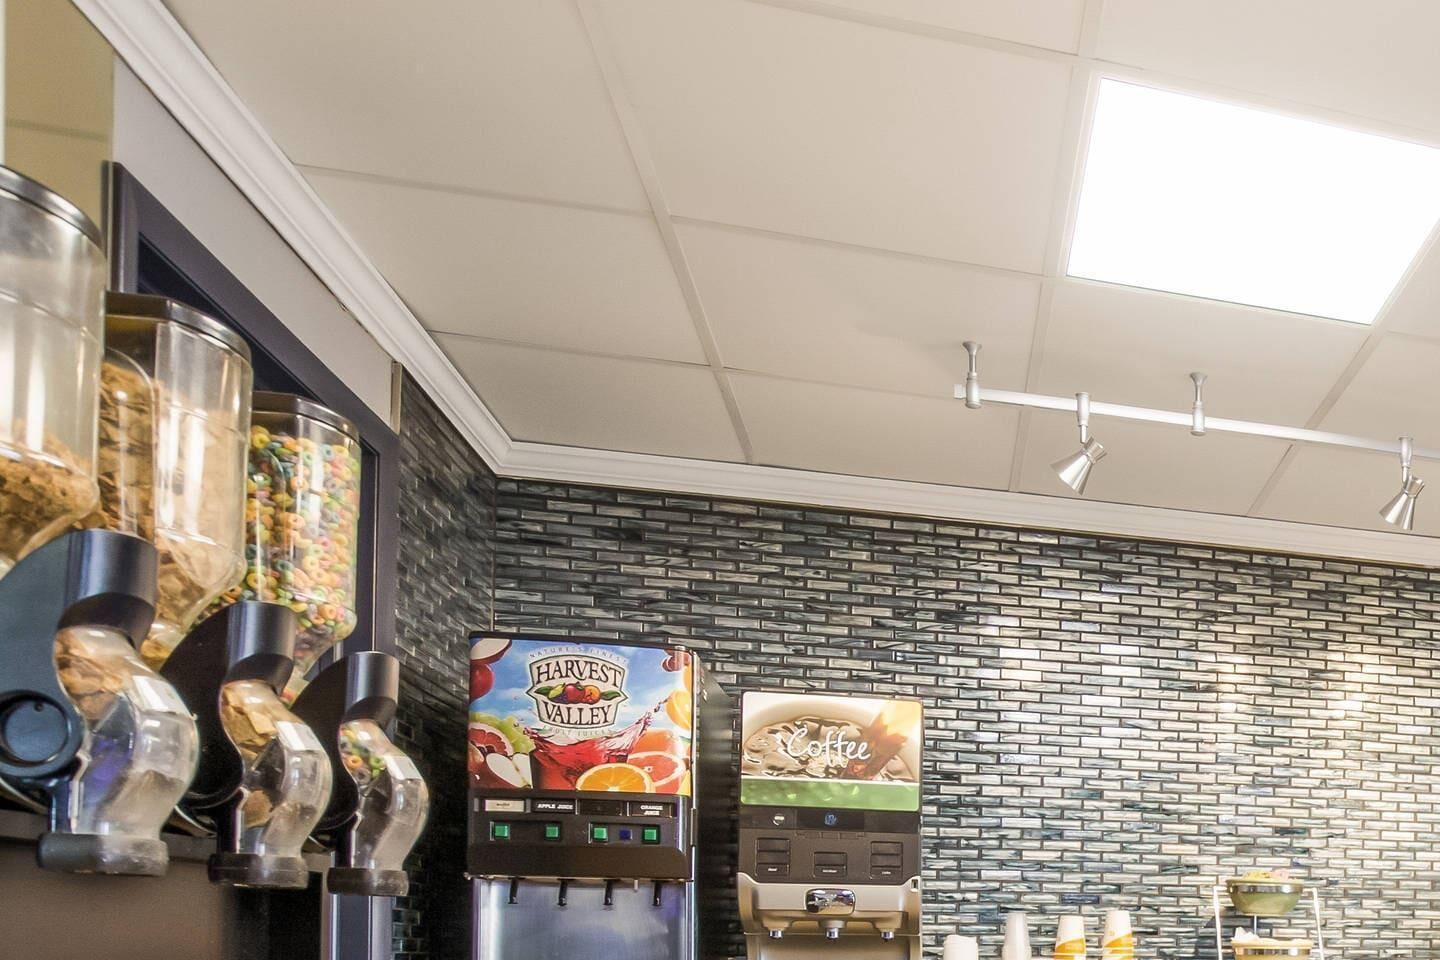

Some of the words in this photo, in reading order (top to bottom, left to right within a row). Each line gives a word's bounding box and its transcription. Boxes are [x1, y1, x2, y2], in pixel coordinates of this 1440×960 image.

[535, 659, 622, 688] HARVEST
[543, 701, 612, 726] VALLEY
[786, 724, 871, 768] Coffee
